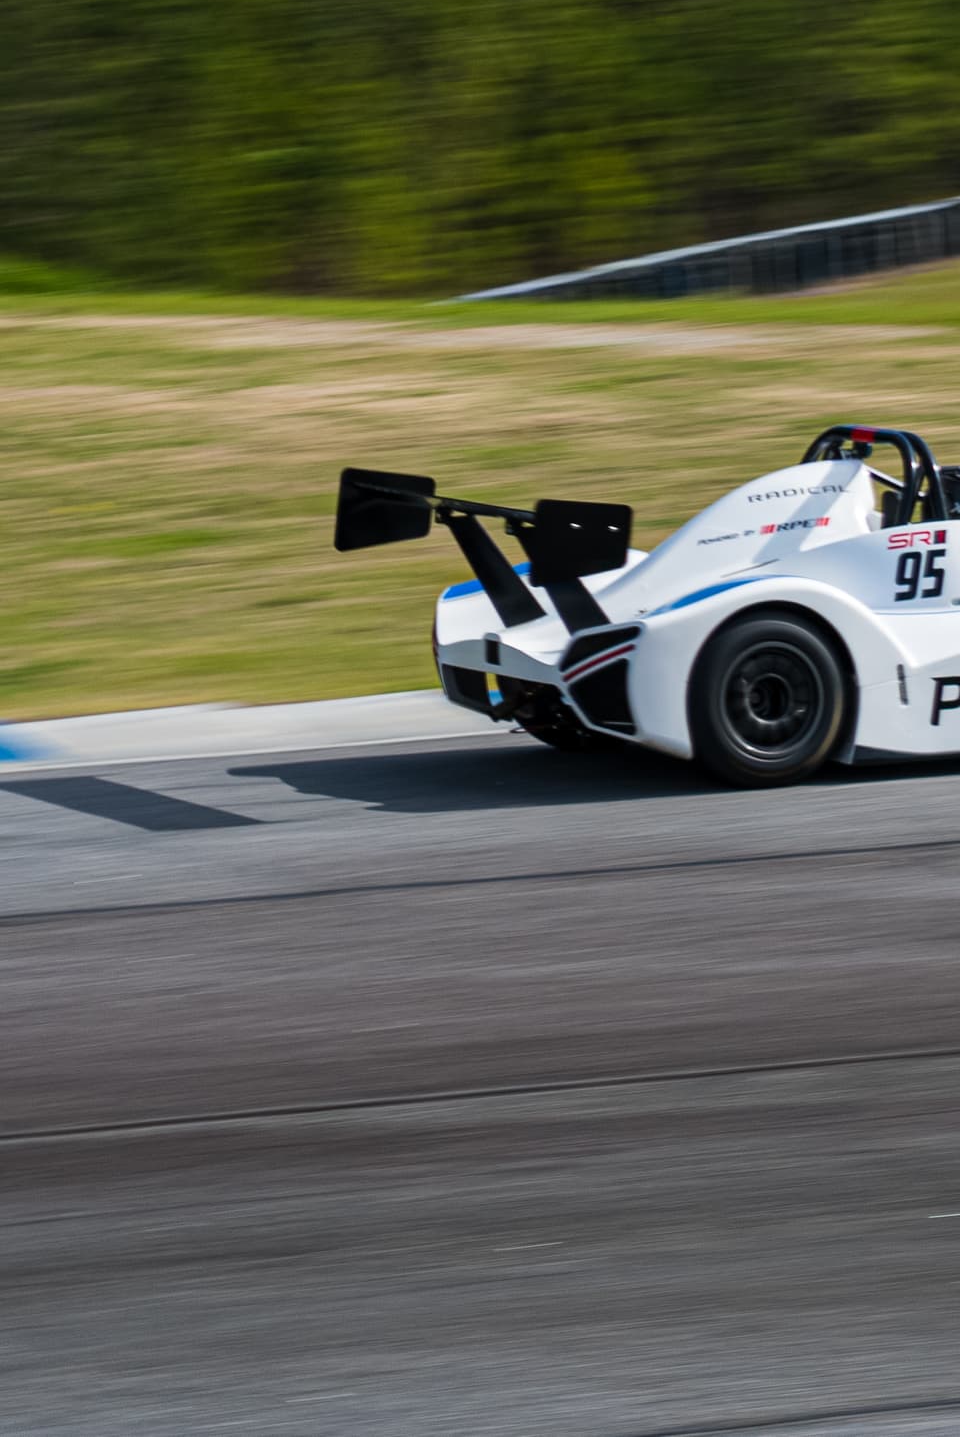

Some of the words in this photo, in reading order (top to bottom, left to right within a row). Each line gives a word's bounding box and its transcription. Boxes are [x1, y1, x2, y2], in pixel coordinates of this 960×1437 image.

[748, 484, 849, 503] RADICAL
[776, 519, 815, 532] RPE
[894, 548, 946, 602] 95
